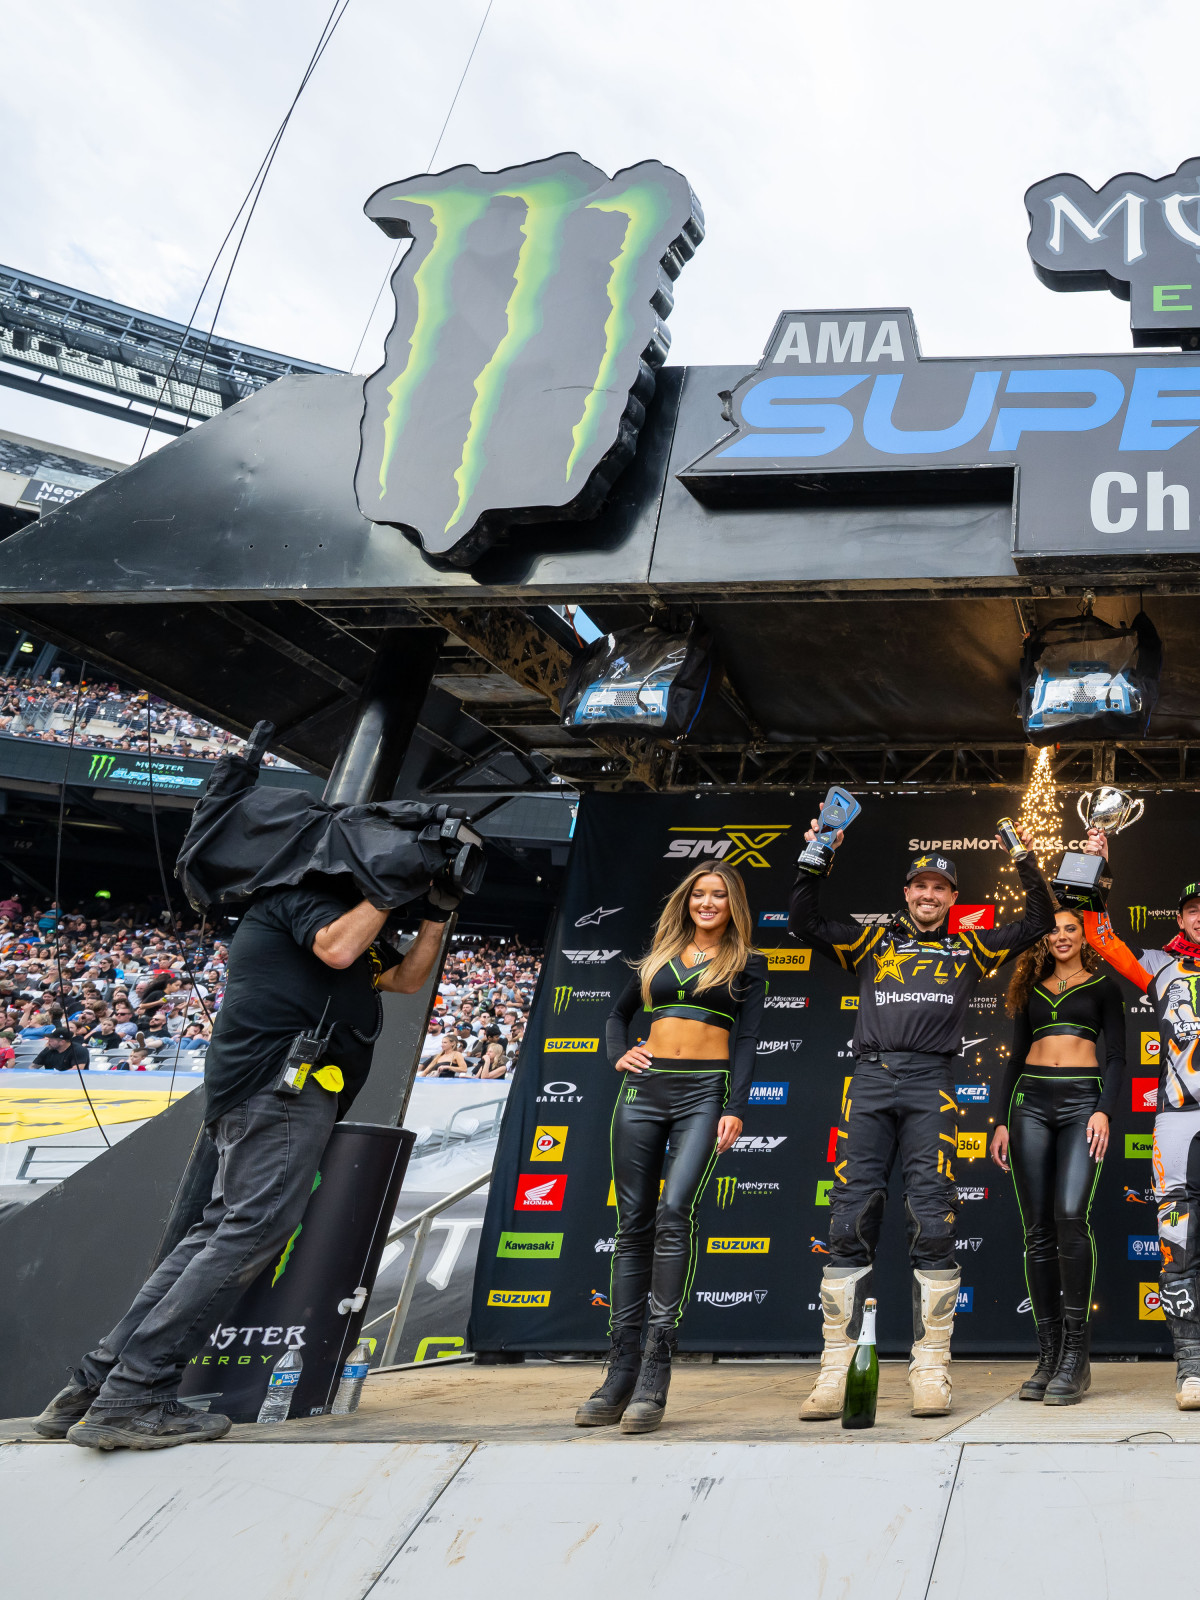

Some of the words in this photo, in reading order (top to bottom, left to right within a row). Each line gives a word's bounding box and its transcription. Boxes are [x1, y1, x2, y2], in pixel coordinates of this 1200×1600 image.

[771, 321, 905, 364] AMA
[663, 832, 781, 868] SMX
[763, 913, 789, 921] FAL
[1147, 909, 1179, 917] MONSTE
[562, 949, 622, 961] FLY
[769, 954, 806, 966] sta360
[911, 959, 967, 979] FLY
[572, 990, 611, 999] MONSTER
[886, 990, 954, 1005] Husqvarna
[547, 1041, 594, 1050] SUZUKI
[757, 1041, 789, 1051] UMPH
[737, 1181, 779, 1191] MONSTER
[505, 1241, 555, 1251] Kawasaki
[711, 1241, 765, 1250] SUZUKI
[492, 1293, 546, 1304] SUZUKI
[696, 1291, 752, 1303] TRIUMPH
[209, 1323, 307, 1350] NSTER
[188, 1354, 274, 1365] NERGY
